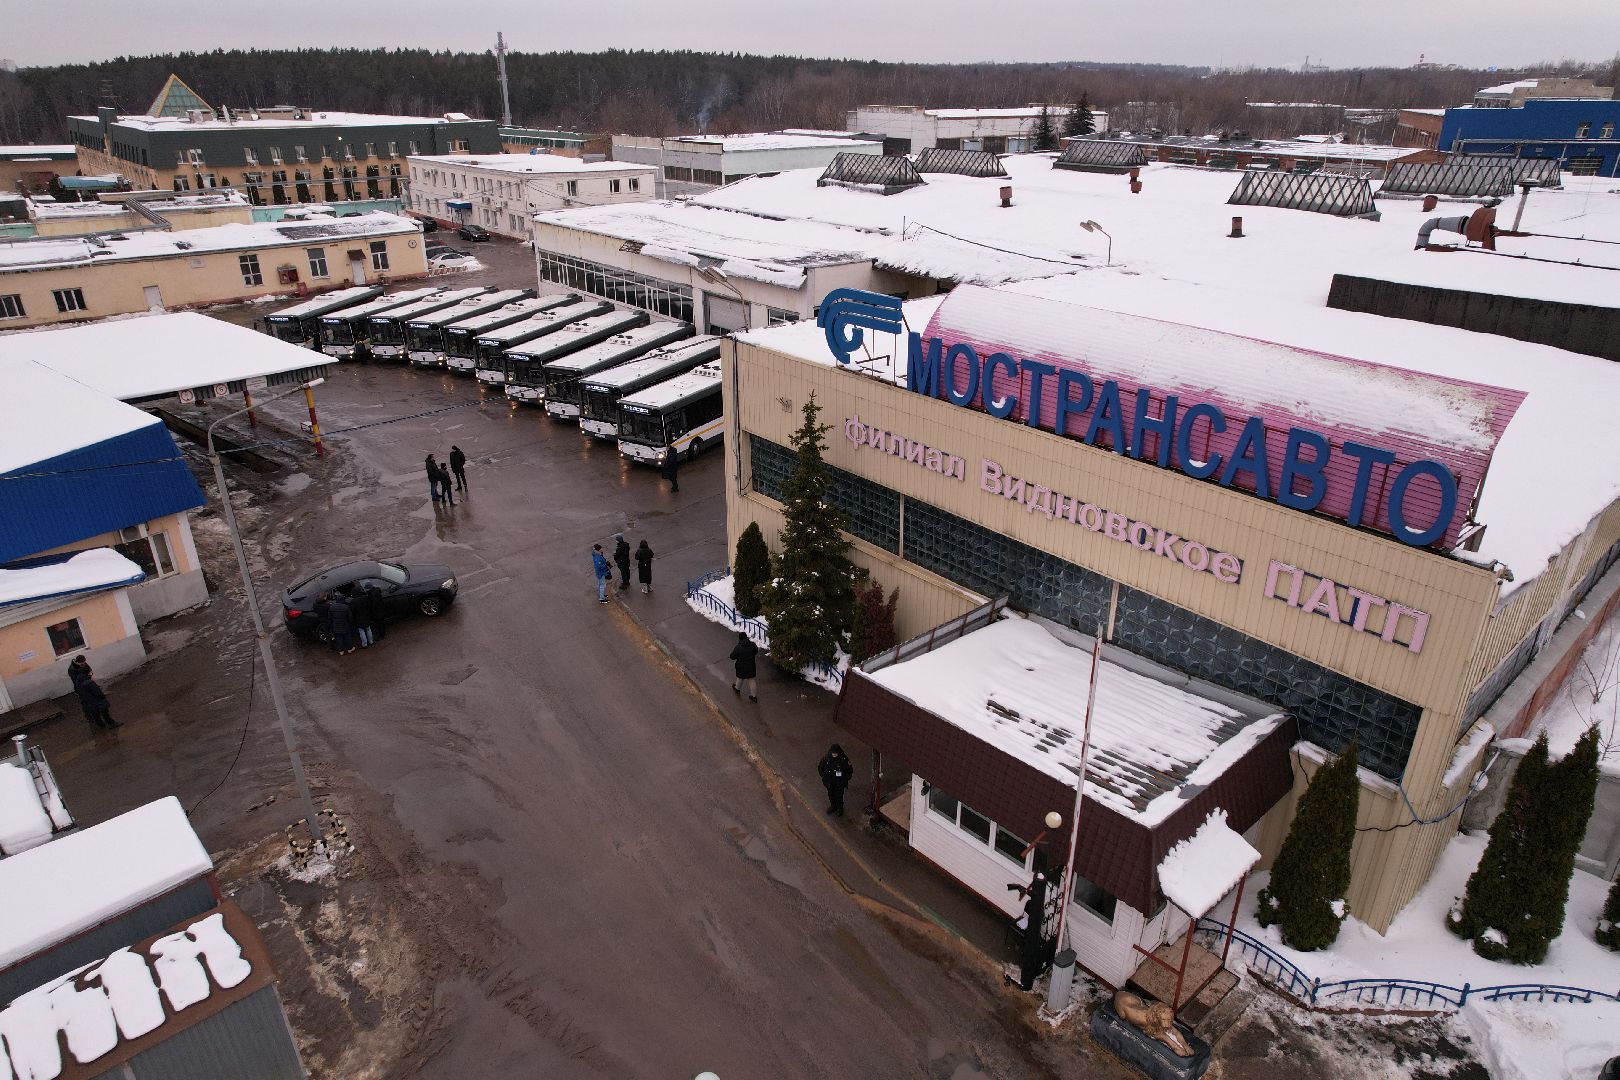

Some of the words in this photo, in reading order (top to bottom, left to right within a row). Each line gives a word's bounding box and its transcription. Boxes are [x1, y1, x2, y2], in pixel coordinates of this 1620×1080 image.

[845, 414, 966, 482] филиал
[980, 457, 1244, 585] Видновское
[1264, 559, 1431, 653] ПАТП
[907, 332, 1458, 547] МОСТРАНСАВТО
